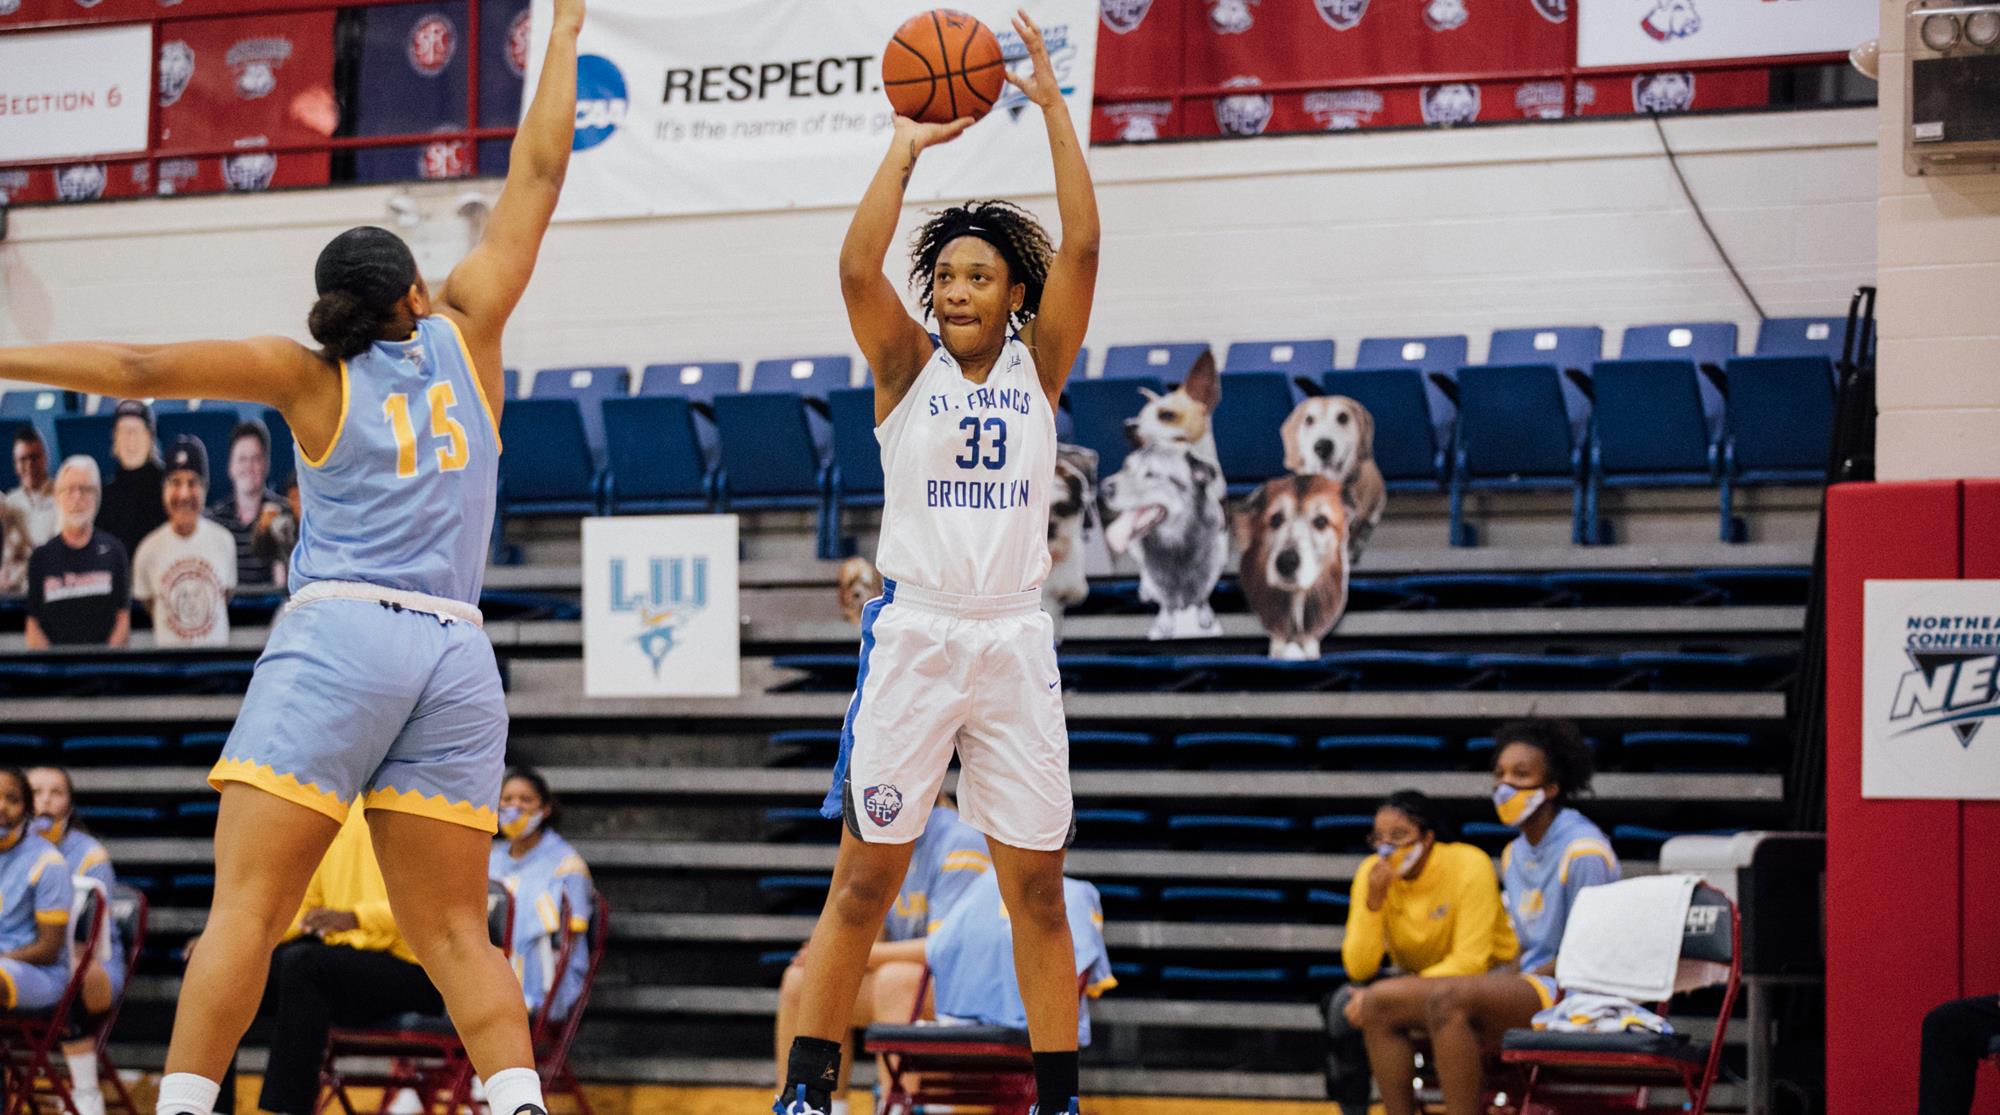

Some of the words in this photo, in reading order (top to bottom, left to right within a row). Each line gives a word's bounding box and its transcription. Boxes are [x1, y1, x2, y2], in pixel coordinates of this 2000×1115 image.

[660, 55, 881, 104] RESPECT.
[0, 91, 96, 116] SECTION
[106, 84, 122, 108] 6
[656, 119, 687, 141] It's
[693, 117, 724, 139] the
[732, 117, 793, 138] name
[799, 112, 826, 136] of
[830, 111, 866, 133] the
[929, 393, 960, 417] ST.
[966, 387, 1031, 415] FRANCS
[382, 379, 471, 479] 15
[955, 416, 1007, 470] 33
[927, 479, 1029, 510] BROOKLYN
[609, 558, 708, 612] LIU
[1906, 633, 2000, 648] CONFERE
[1889, 654, 2000, 721] NE
[866, 798, 892, 822] SFC
